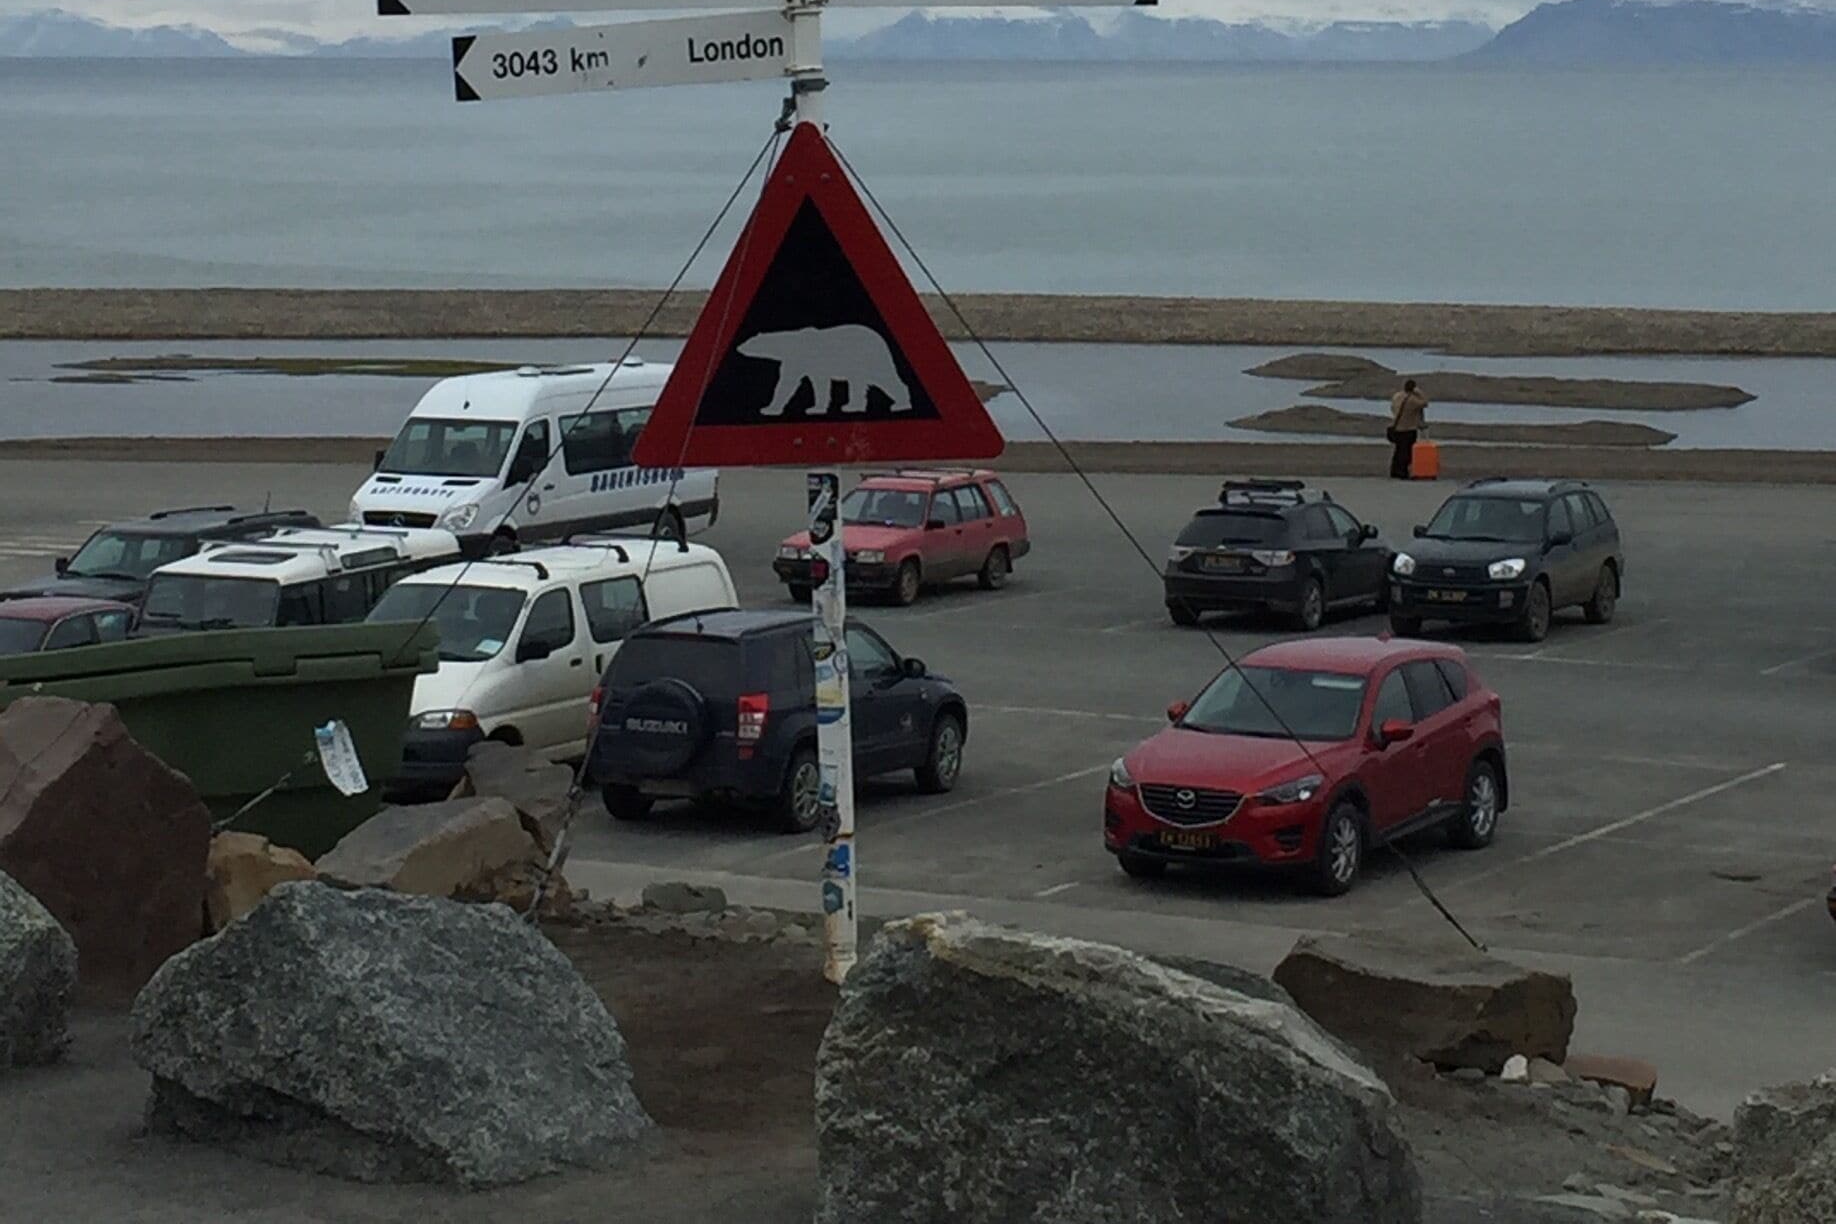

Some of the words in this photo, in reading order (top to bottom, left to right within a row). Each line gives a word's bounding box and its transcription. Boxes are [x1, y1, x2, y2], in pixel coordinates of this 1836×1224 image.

[492, 48, 558, 79] 3043
[570, 47, 609, 73] km
[688, 33, 784, 63] London
